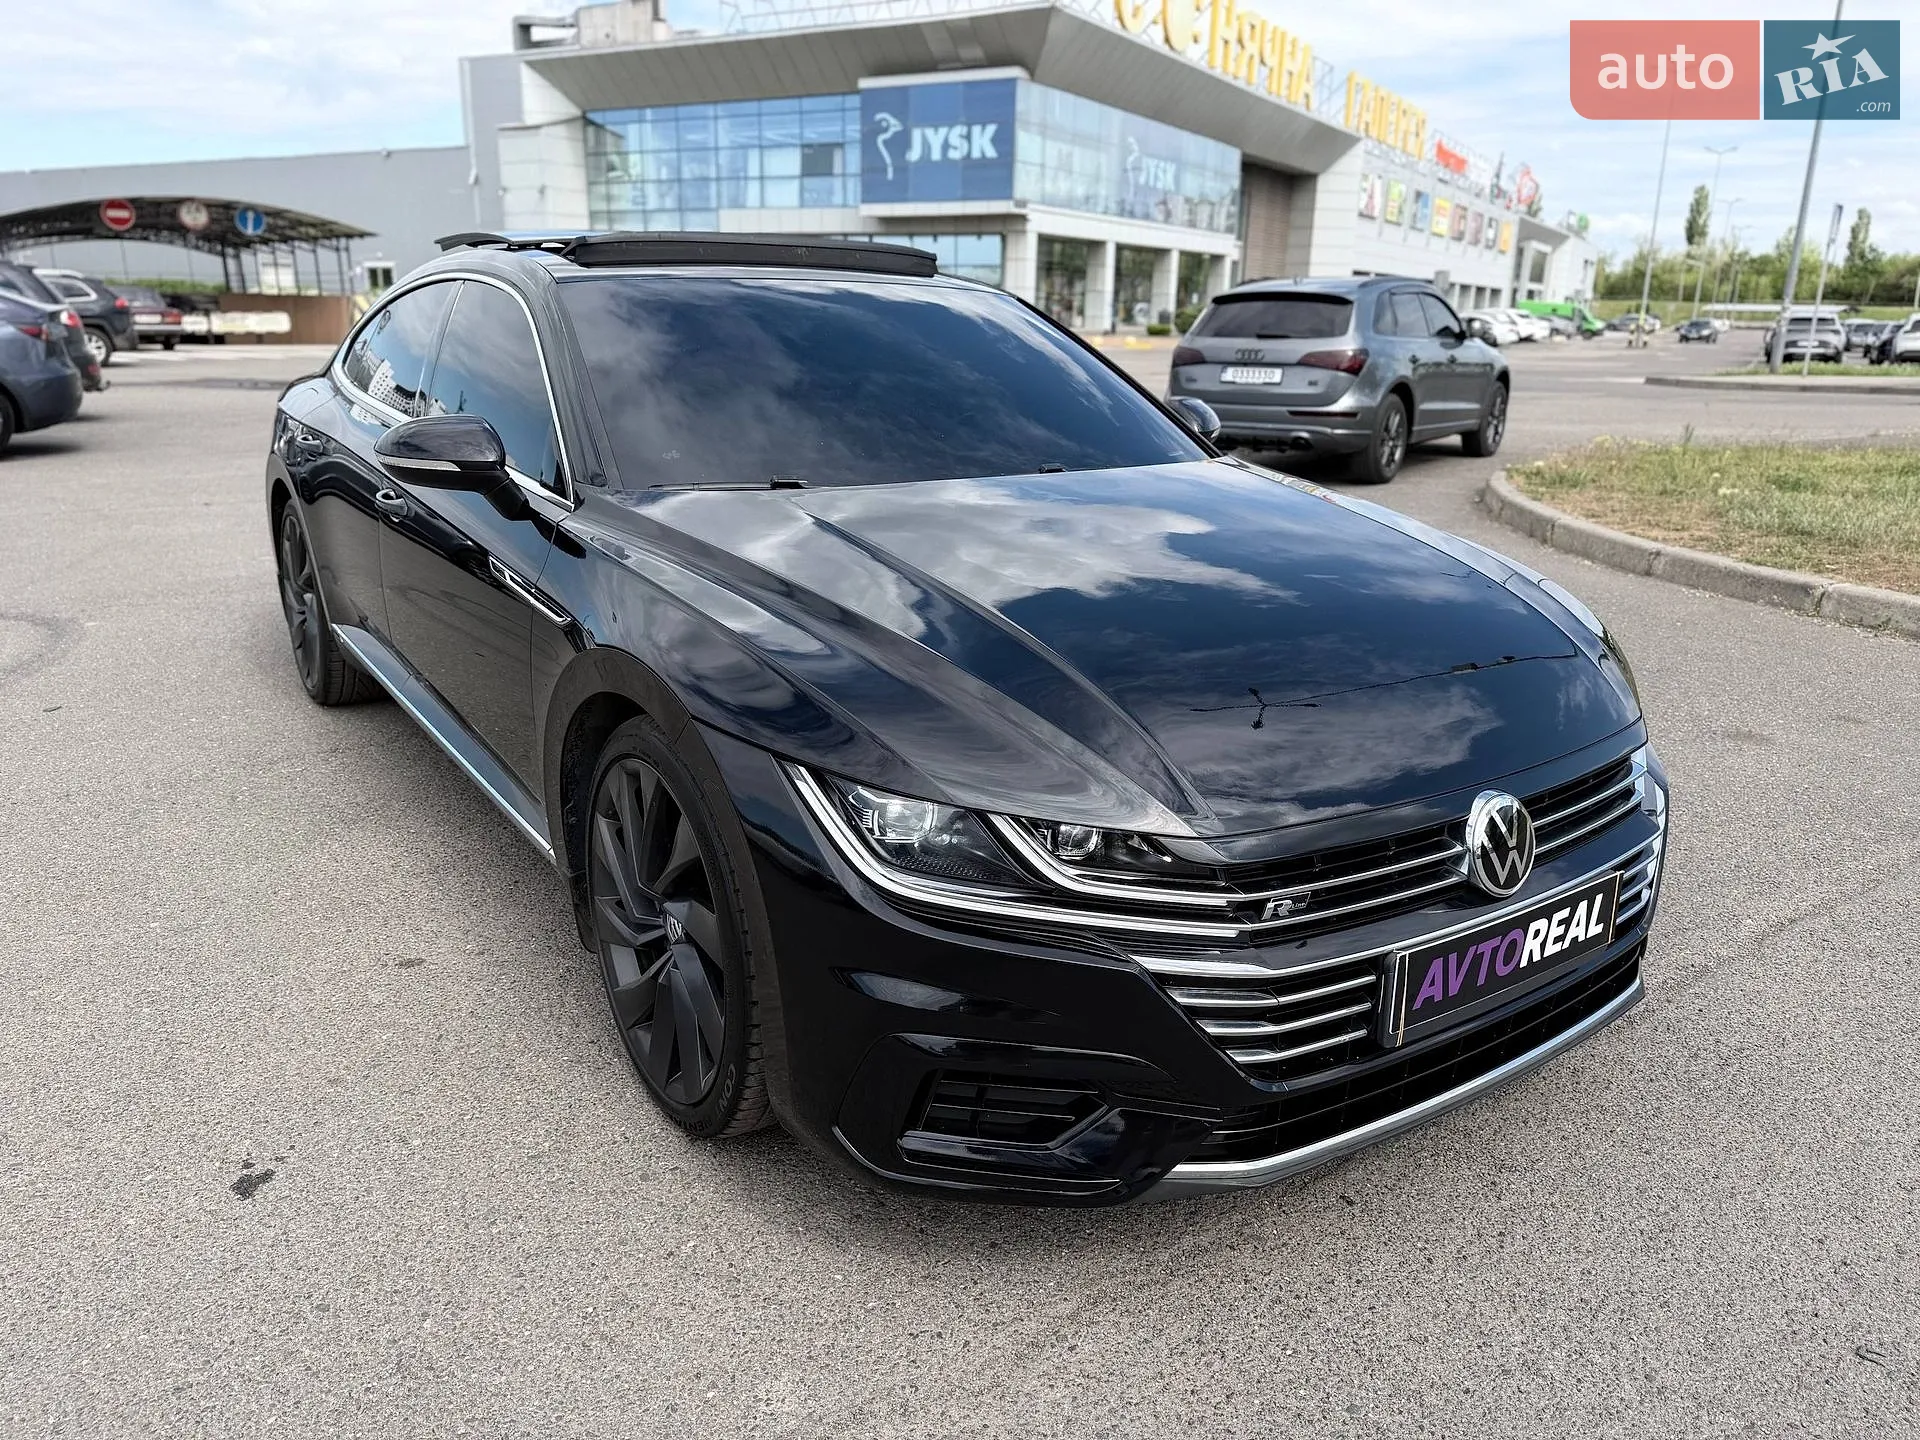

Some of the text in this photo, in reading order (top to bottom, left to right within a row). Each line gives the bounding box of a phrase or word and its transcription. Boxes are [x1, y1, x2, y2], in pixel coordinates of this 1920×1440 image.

[905, 123, 999, 162] JYSK
[1139, 155, 1177, 191] JYSK
[1411, 892, 1604, 1011] AVTOREAL
